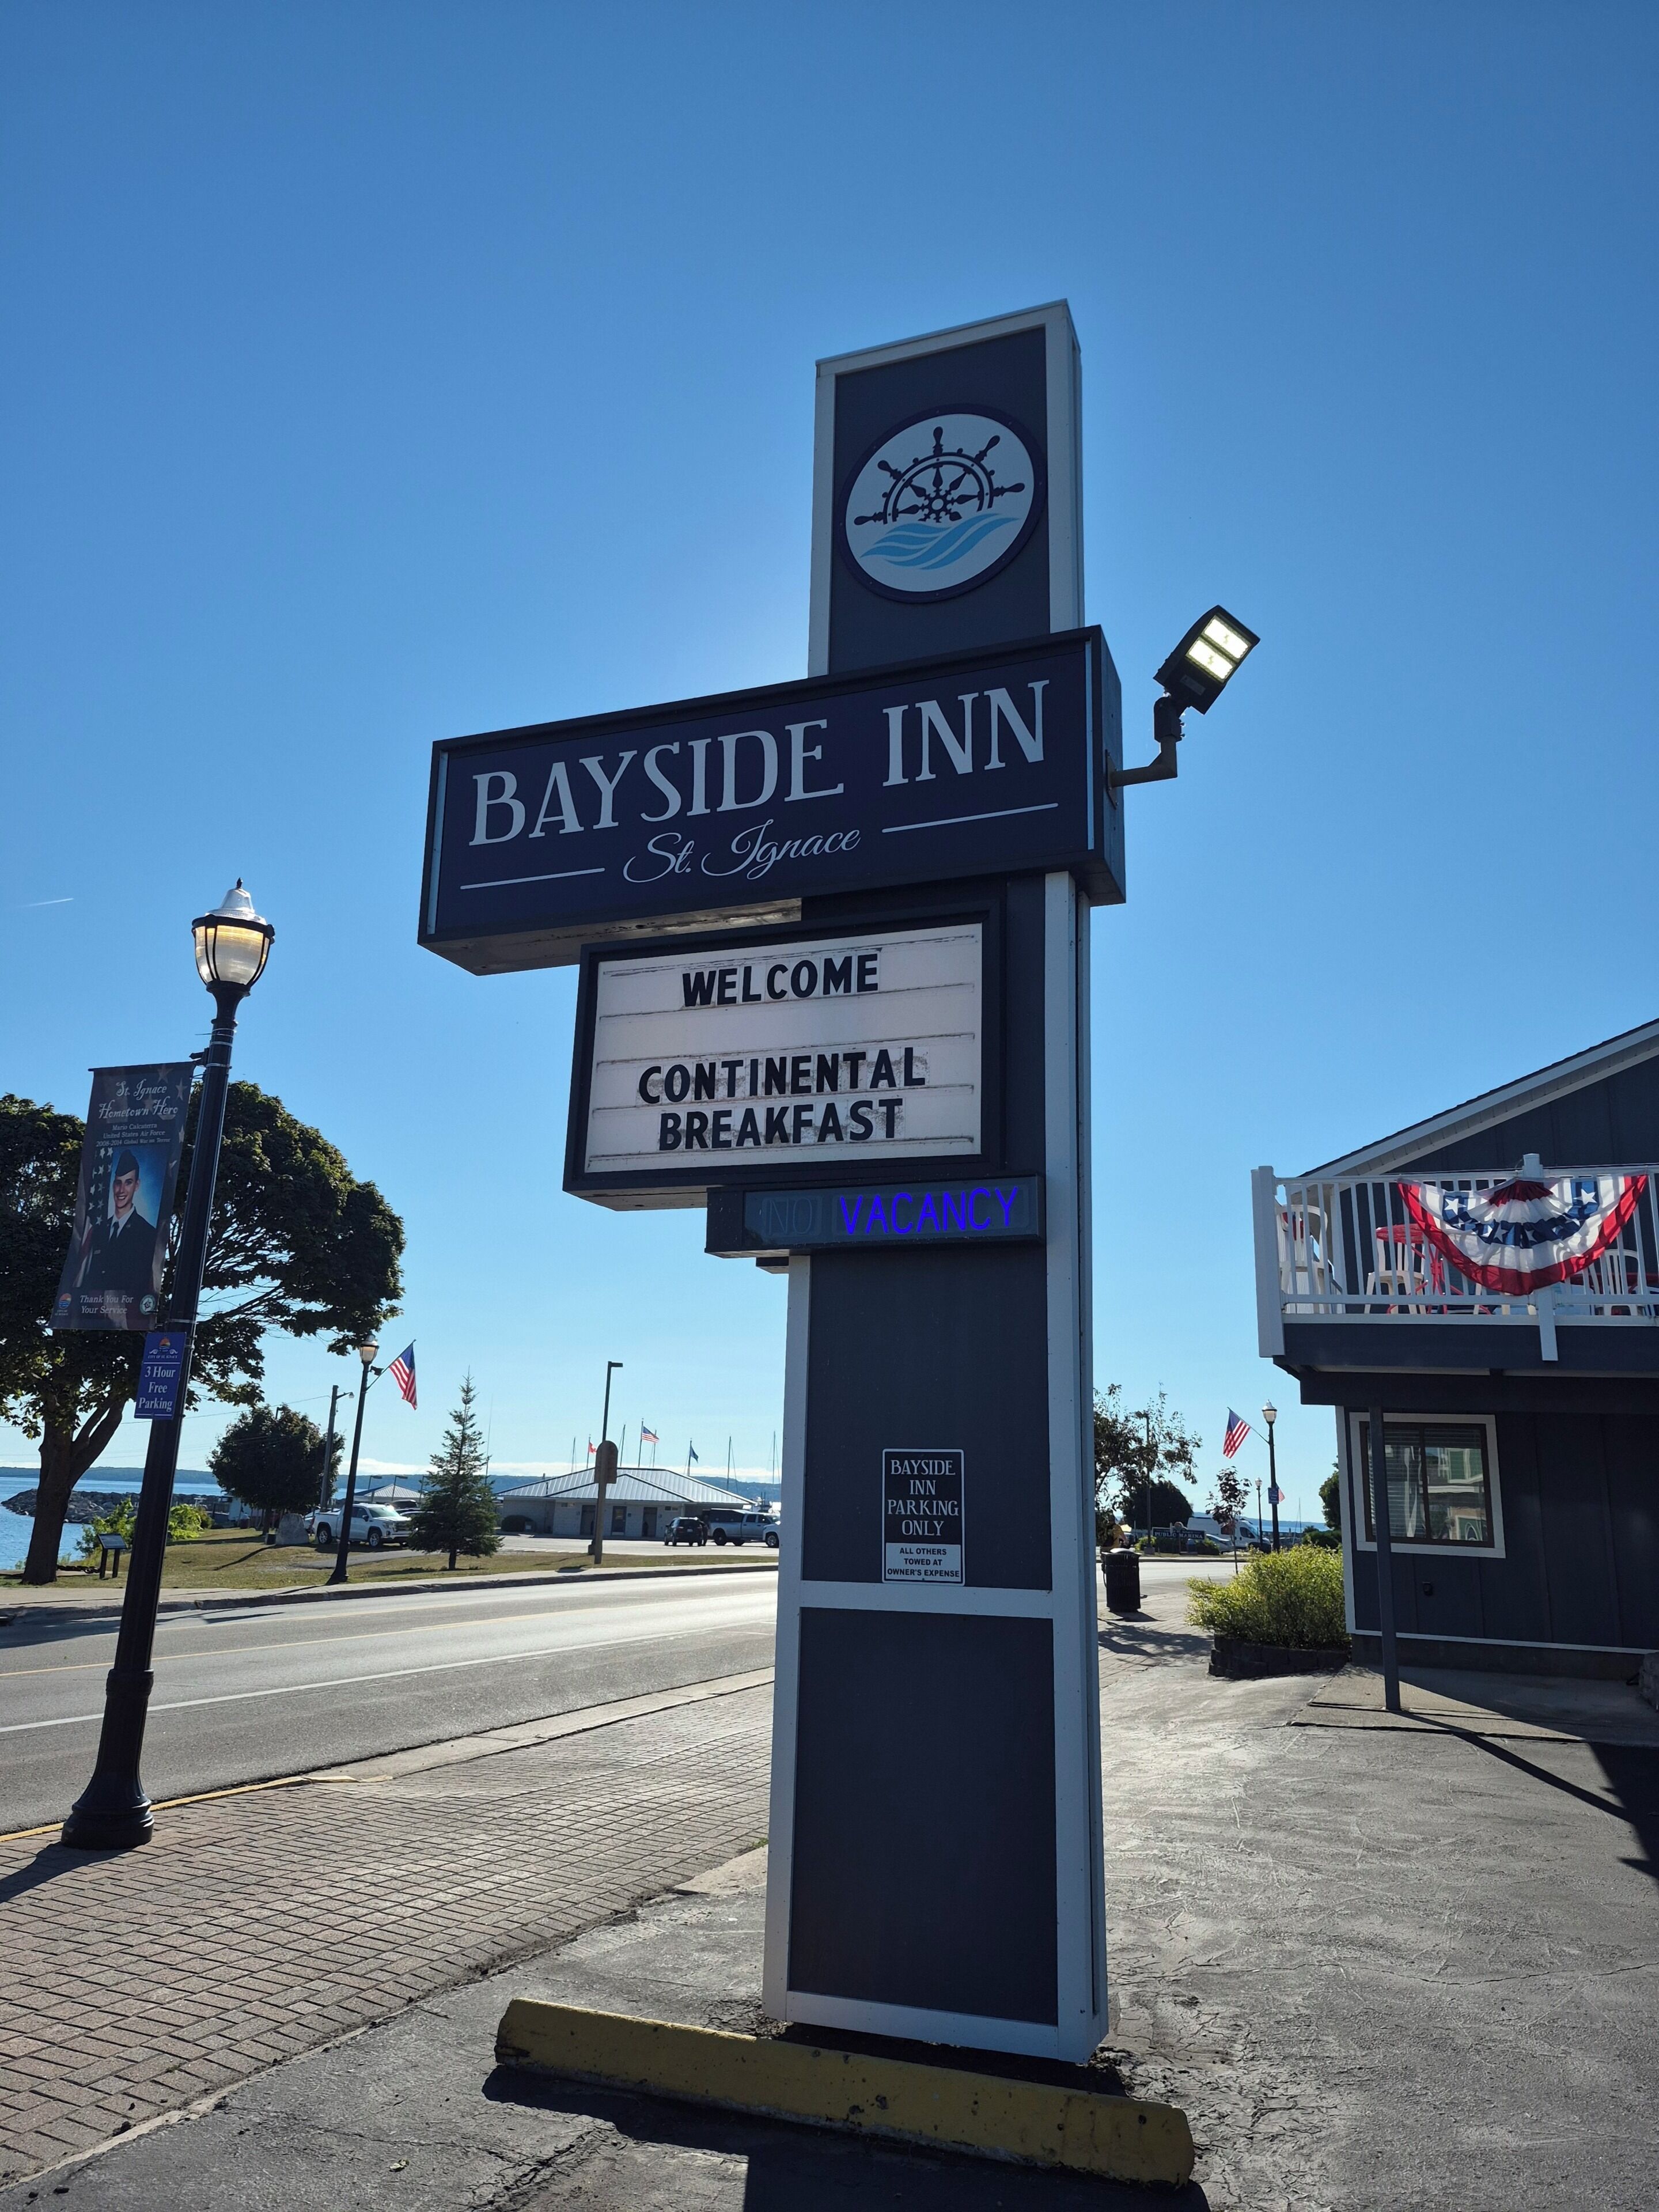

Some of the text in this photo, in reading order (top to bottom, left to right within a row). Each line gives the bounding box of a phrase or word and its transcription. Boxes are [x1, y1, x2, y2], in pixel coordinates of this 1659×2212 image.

[468, 679, 1049, 847] BAYSIDE INN
[623, 819, 861, 884] St. Ignace
[682, 953, 879, 1007] WELCOME
[638, 1046, 926, 1104] CONTINENTAL
[116, 1079, 167, 1100] St. Ignace
[99, 1096, 179, 1119] Hometown Hero
[658, 1098, 903, 1152] BREAKFAST
[768, 1186, 1018, 1236] NO VACANCY
[79, 1295, 104, 1303] Thank
[81, 1306, 127, 1314] Your Service
[145, 1366, 176, 1378] 3 Hour
[148, 1382, 167, 1393] Free
[138, 1397, 173, 1412] Parking
[891, 1460, 956, 1475] BAYSIDE
[910, 1480, 936, 1495] INN
[887, 1499, 959, 1516] PARKING
[902, 1520, 944, 1536] ONLY
[924, 1569, 960, 1577] EXPENSE
